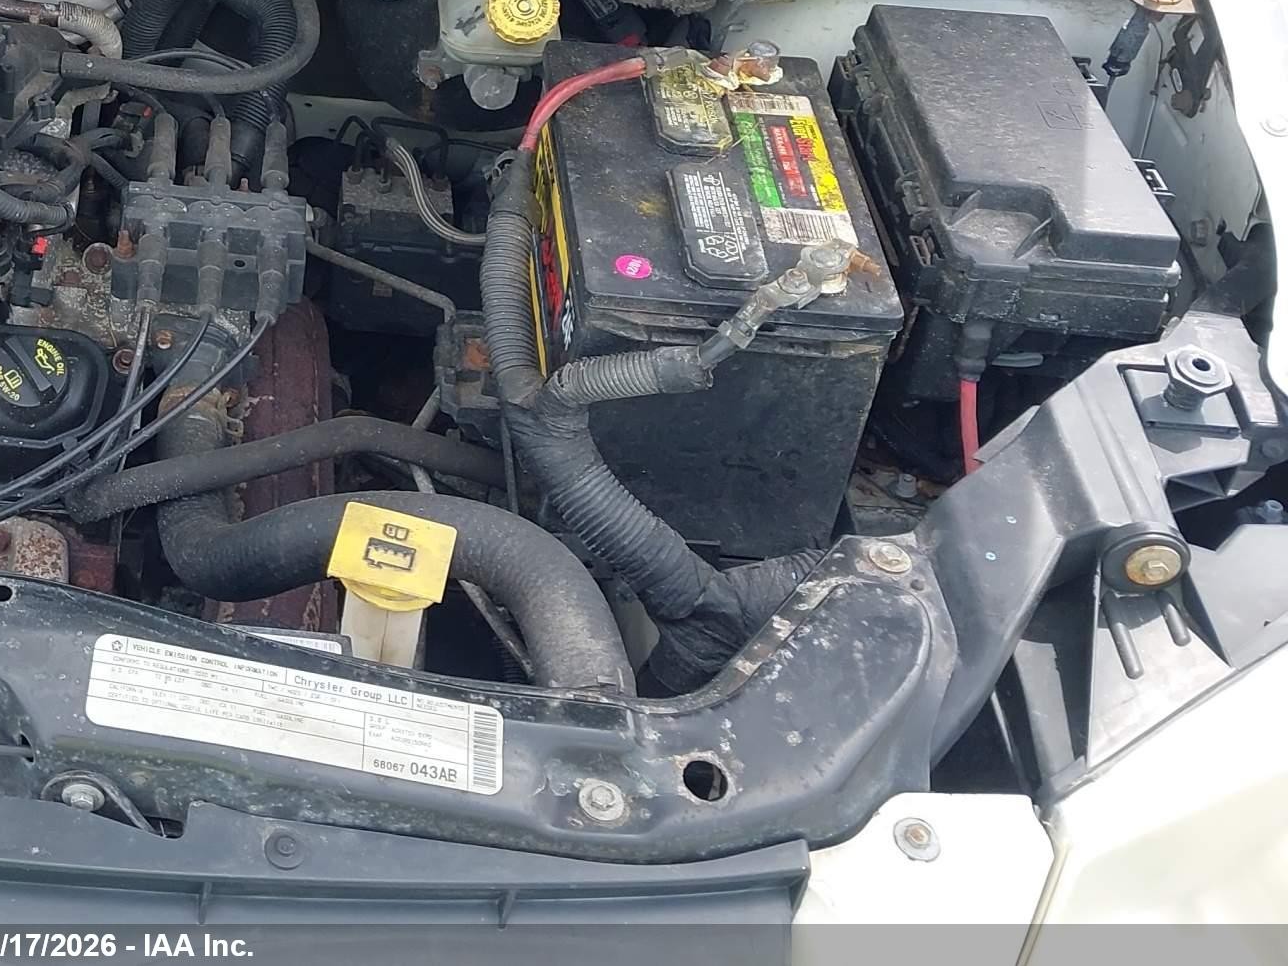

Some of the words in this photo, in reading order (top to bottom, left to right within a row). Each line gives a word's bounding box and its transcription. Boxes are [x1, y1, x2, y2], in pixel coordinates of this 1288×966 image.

[36, 338, 63, 363] ENGINE
[56, 362, 65, 376] OIL
[132, 643, 161, 655] VEHICLE
[164, 649, 198, 663] EMISSION
[200, 655, 229, 668] CONTROL
[233, 663, 278, 678] INFORMATION
[294, 675, 344, 693] Chrysler
[350, 686, 383, 703] Group
[388, 693, 408, 706] LLC
[373, 759, 405, 772] 68067
